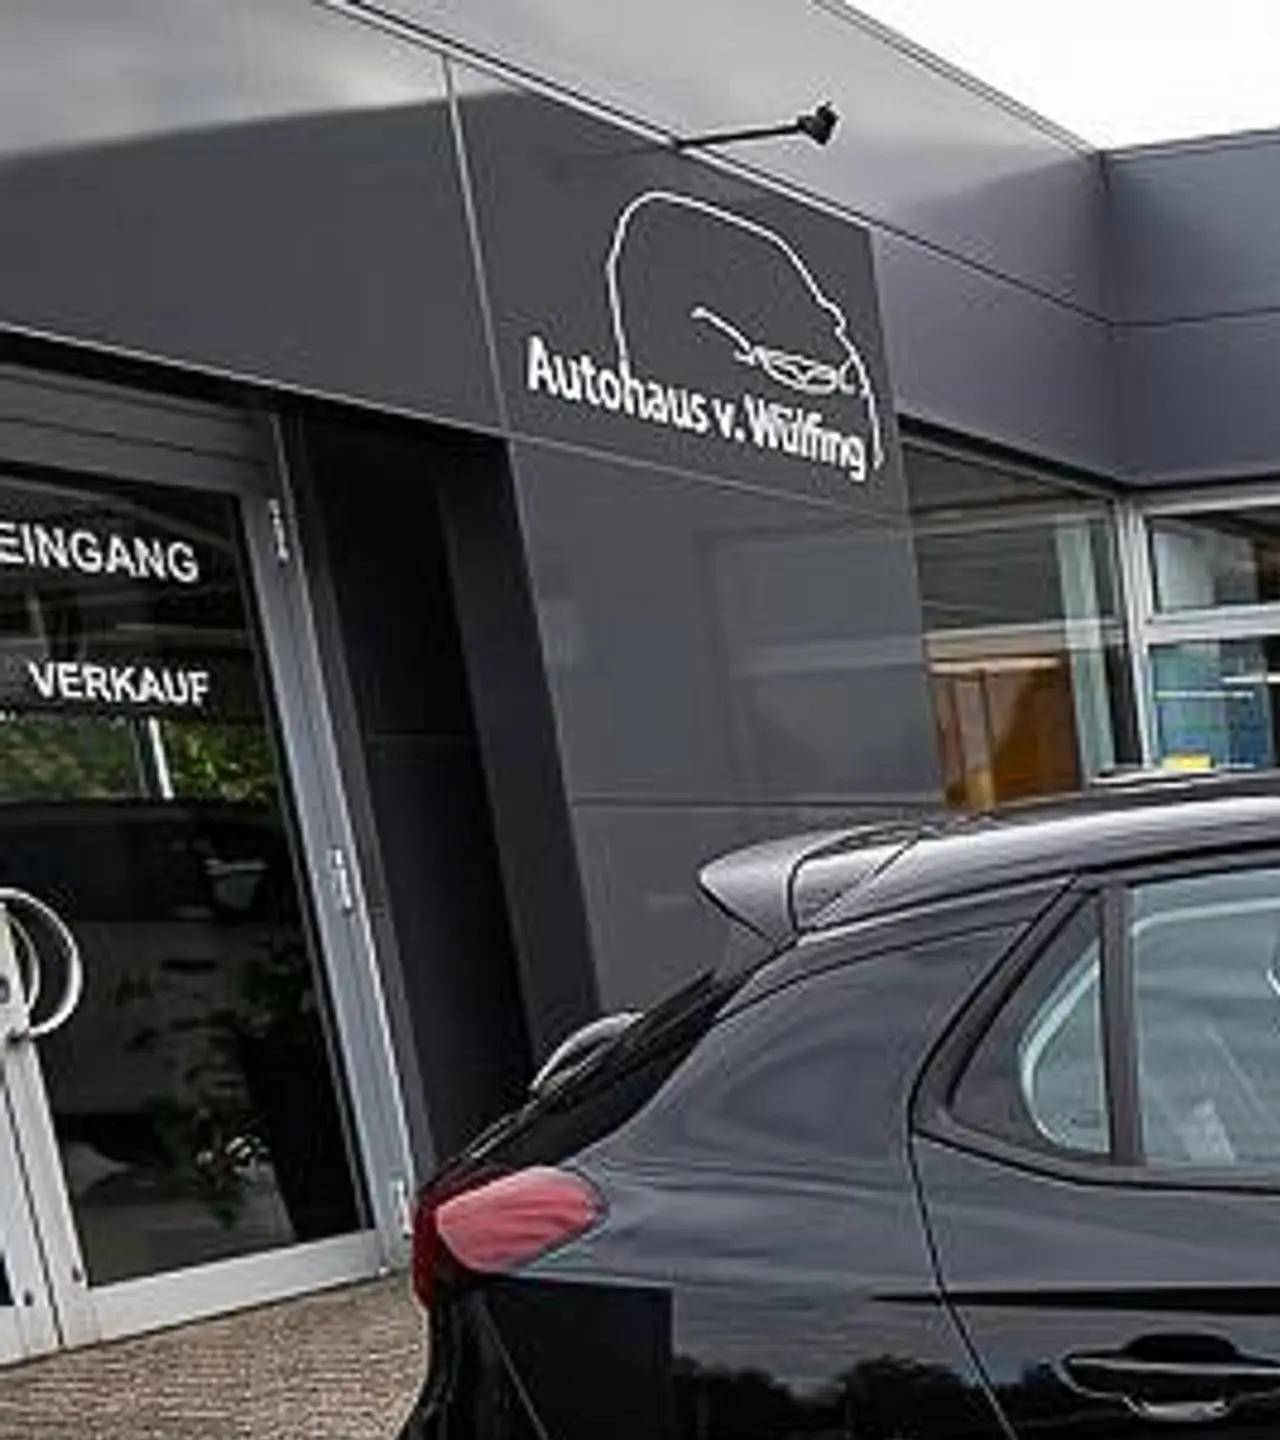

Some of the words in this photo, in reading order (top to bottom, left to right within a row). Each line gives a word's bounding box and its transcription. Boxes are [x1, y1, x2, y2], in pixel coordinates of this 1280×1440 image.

[527, 336, 708, 434] Autohaus
[713, 398, 746, 443] v.
[744, 393, 867, 483] Wülfing
[0, 522, 200, 584] EINGANG
[27, 661, 210, 706] VERKAUF
